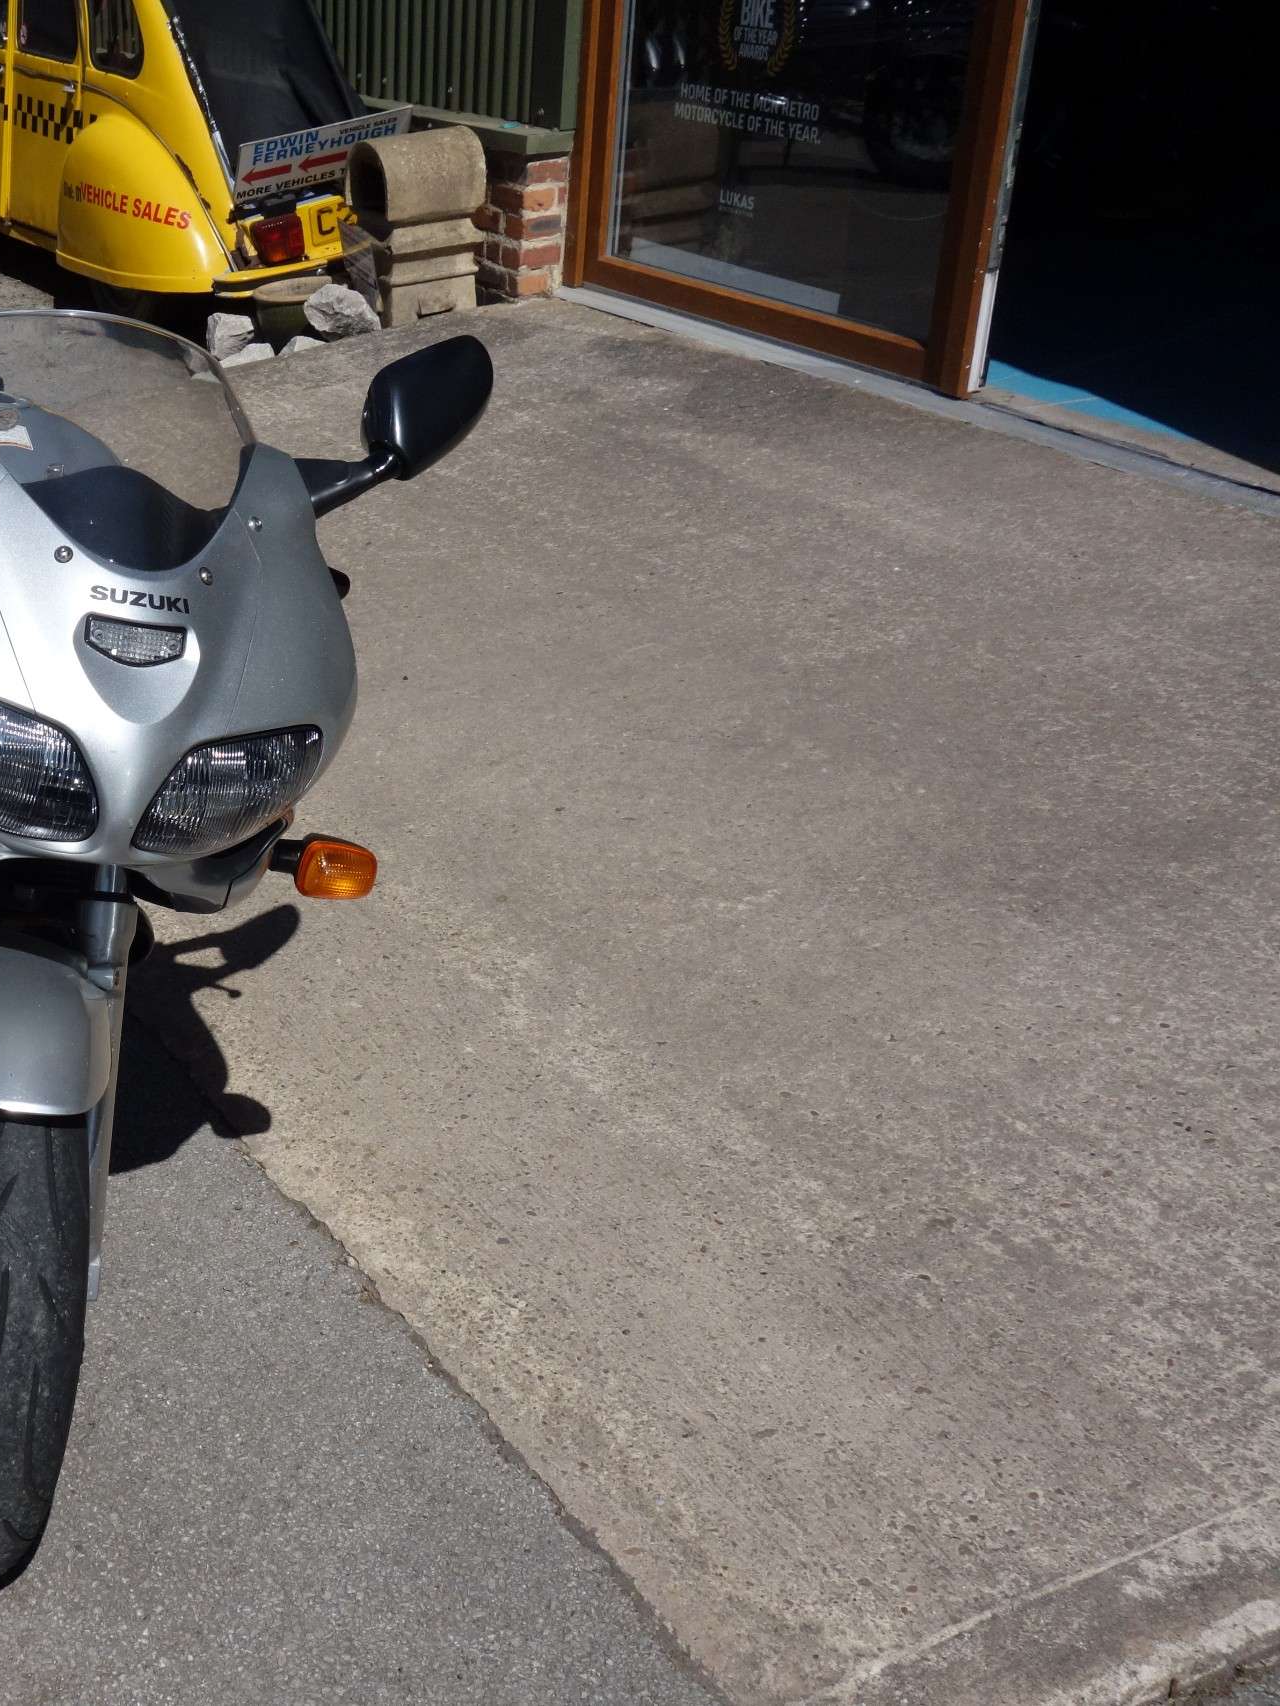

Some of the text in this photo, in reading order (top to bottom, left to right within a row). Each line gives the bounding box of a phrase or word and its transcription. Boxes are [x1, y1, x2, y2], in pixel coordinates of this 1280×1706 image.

[740, 0, 776, 28] BIKE
[680, 82, 712, 103] HOME
[714, 87, 729, 105] OF
[730, 90, 751, 110] THE
[781, 99, 820, 121] RETRO
[339, 116, 398, 135] VEHICLE SALES
[674, 102, 745, 129] MOTORCYCLE
[747, 115, 762, 132] OF
[765, 117, 786, 138] THE
[252, 123, 397, 166] FERNEYHOUGH
[254, 130, 320, 156] EDWIN
[236, 184, 272, 200] MORE
[275, 171, 336, 191] VEHICLES
[720, 189, 755, 210] LUKAS
[80, 181, 128, 214] VEHICLE
[132, 198, 192, 229] SALES
[89, 585, 190, 614] SUZUKI
